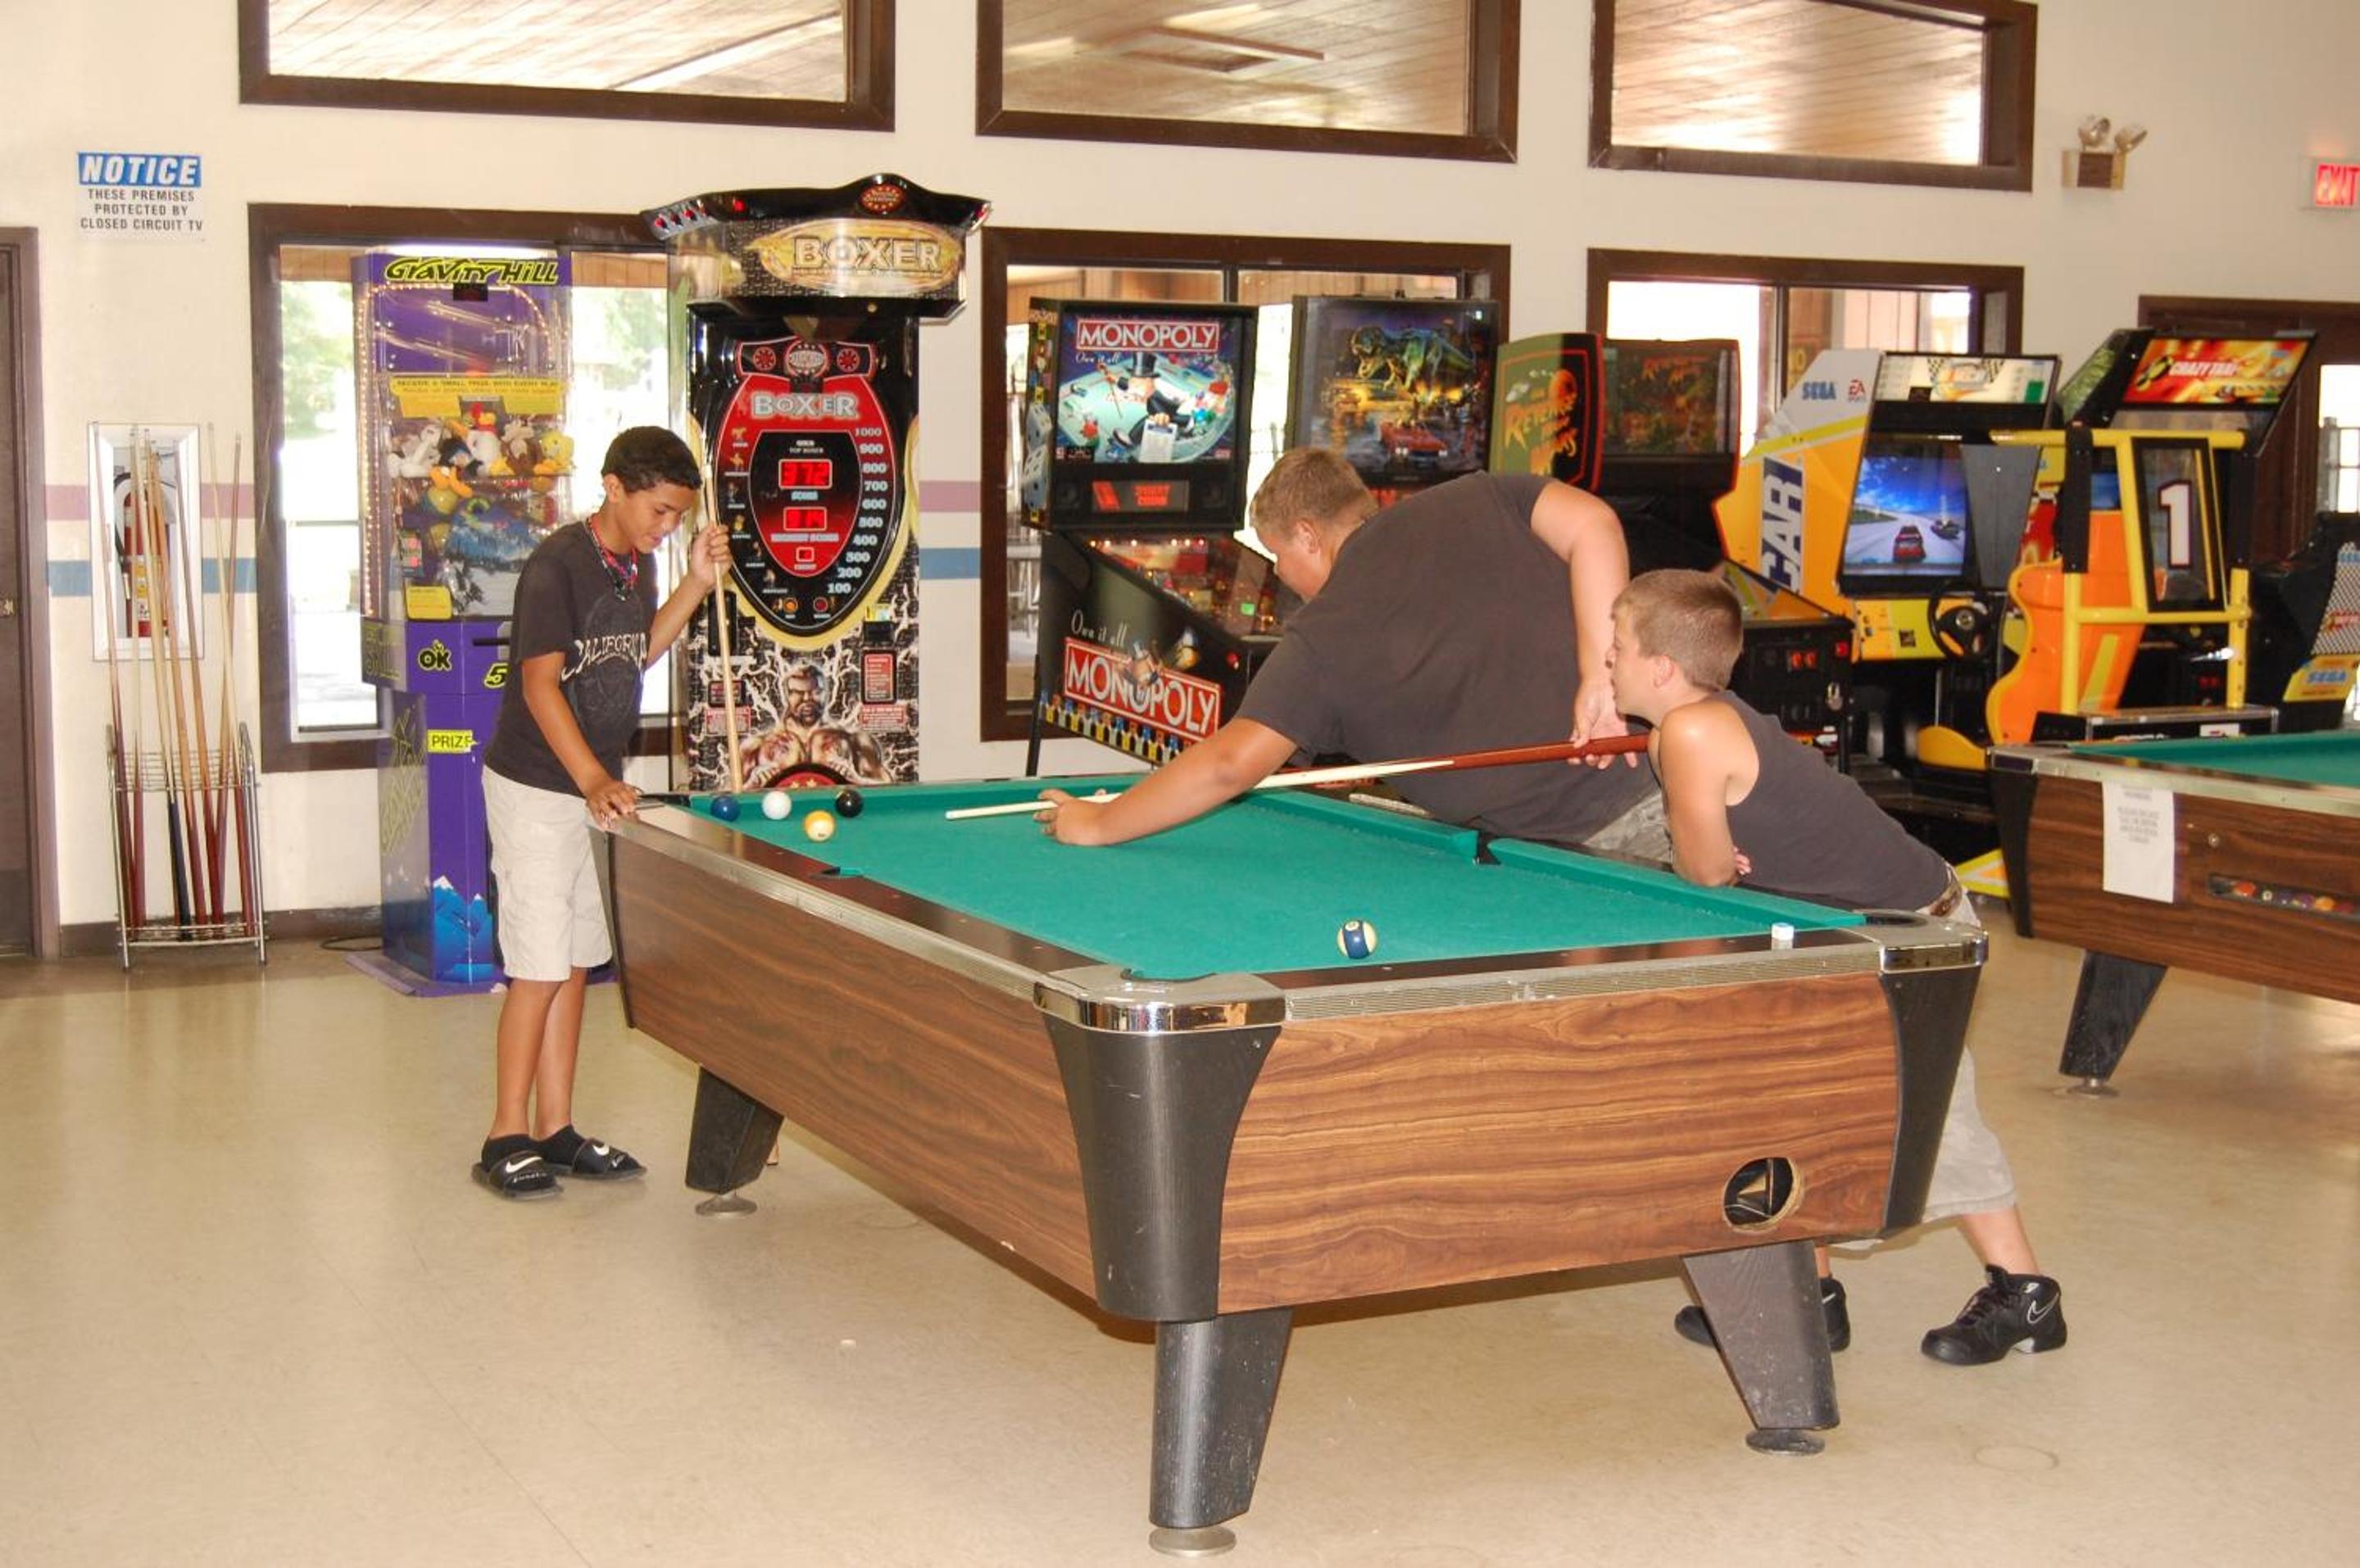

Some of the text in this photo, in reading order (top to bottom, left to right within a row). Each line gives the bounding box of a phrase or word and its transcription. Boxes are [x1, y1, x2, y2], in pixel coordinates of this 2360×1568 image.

[82, 156, 198, 184] NOTICE
[2317, 164, 2360, 206] EXIT
[88, 188, 194, 202] THESE PREMISES
[95, 204, 188, 216] PROTECTED BY
[81, 217, 202, 231] CLOSED CIRCUIT TV
[793, 236, 942, 270] BOXER
[1079, 323, 1217, 349] MONOPOLY
[751, 392, 860, 419] BOXER
[856, 428, 882, 436] 1000
[860, 444, 883, 454] 900
[864, 481, 887, 491] 700
[862, 499, 887, 509] 600
[853, 535, 878, 545] 400
[837, 568, 862, 578] 200
[828, 583, 851, 593] 100
[1071, 609, 1094, 635] Own
[1110, 623, 1128, 647] all
[419, 647, 452, 671] OK
